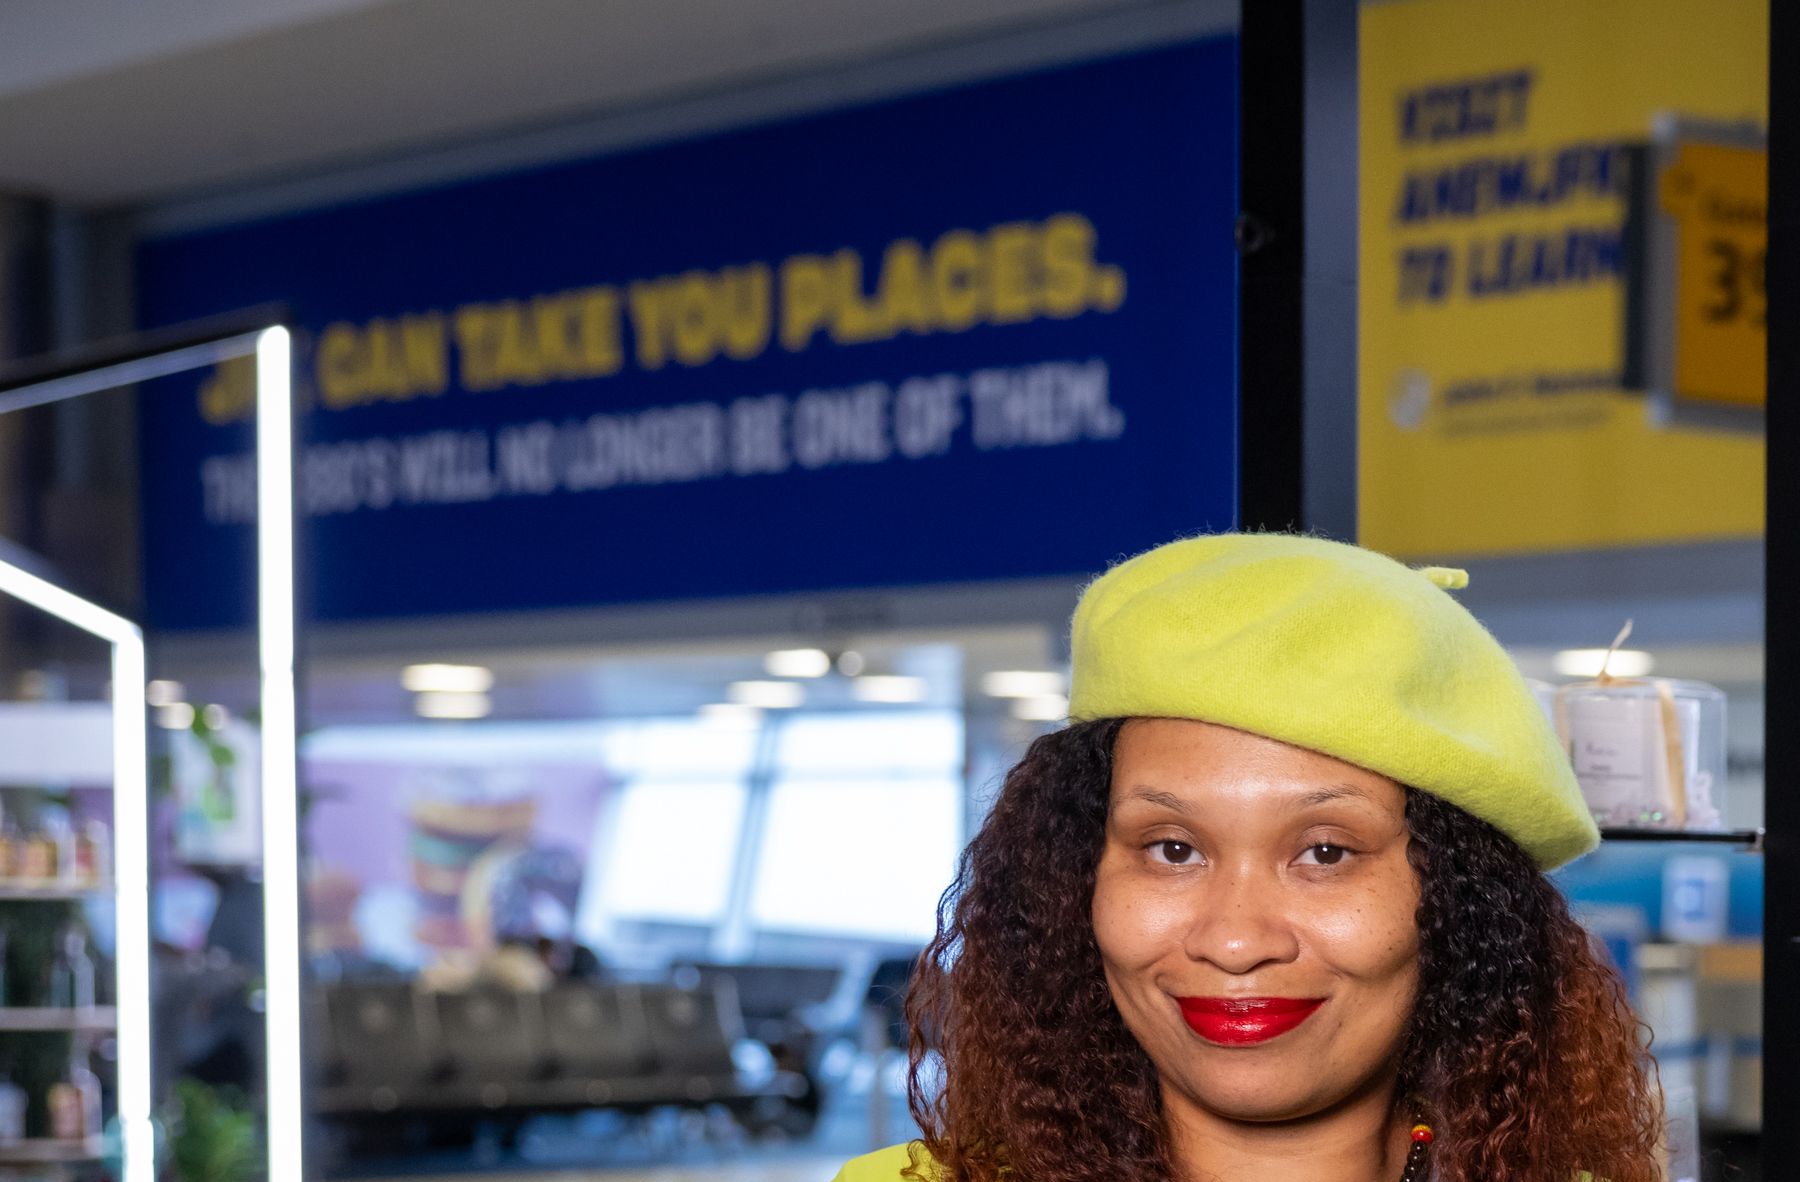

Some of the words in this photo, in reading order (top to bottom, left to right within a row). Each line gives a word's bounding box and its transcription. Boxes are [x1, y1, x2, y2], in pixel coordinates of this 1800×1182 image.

[320, 316, 447, 406] CAN
[456, 286, 620, 388] TAKE
[629, 266, 772, 366] YOU
[781, 217, 1124, 348] PLACES.
[568, 404, 725, 487] LONGER
[730, 395, 787, 472] BE
[797, 383, 888, 467] ONE
[898, 376, 960, 455] OF
